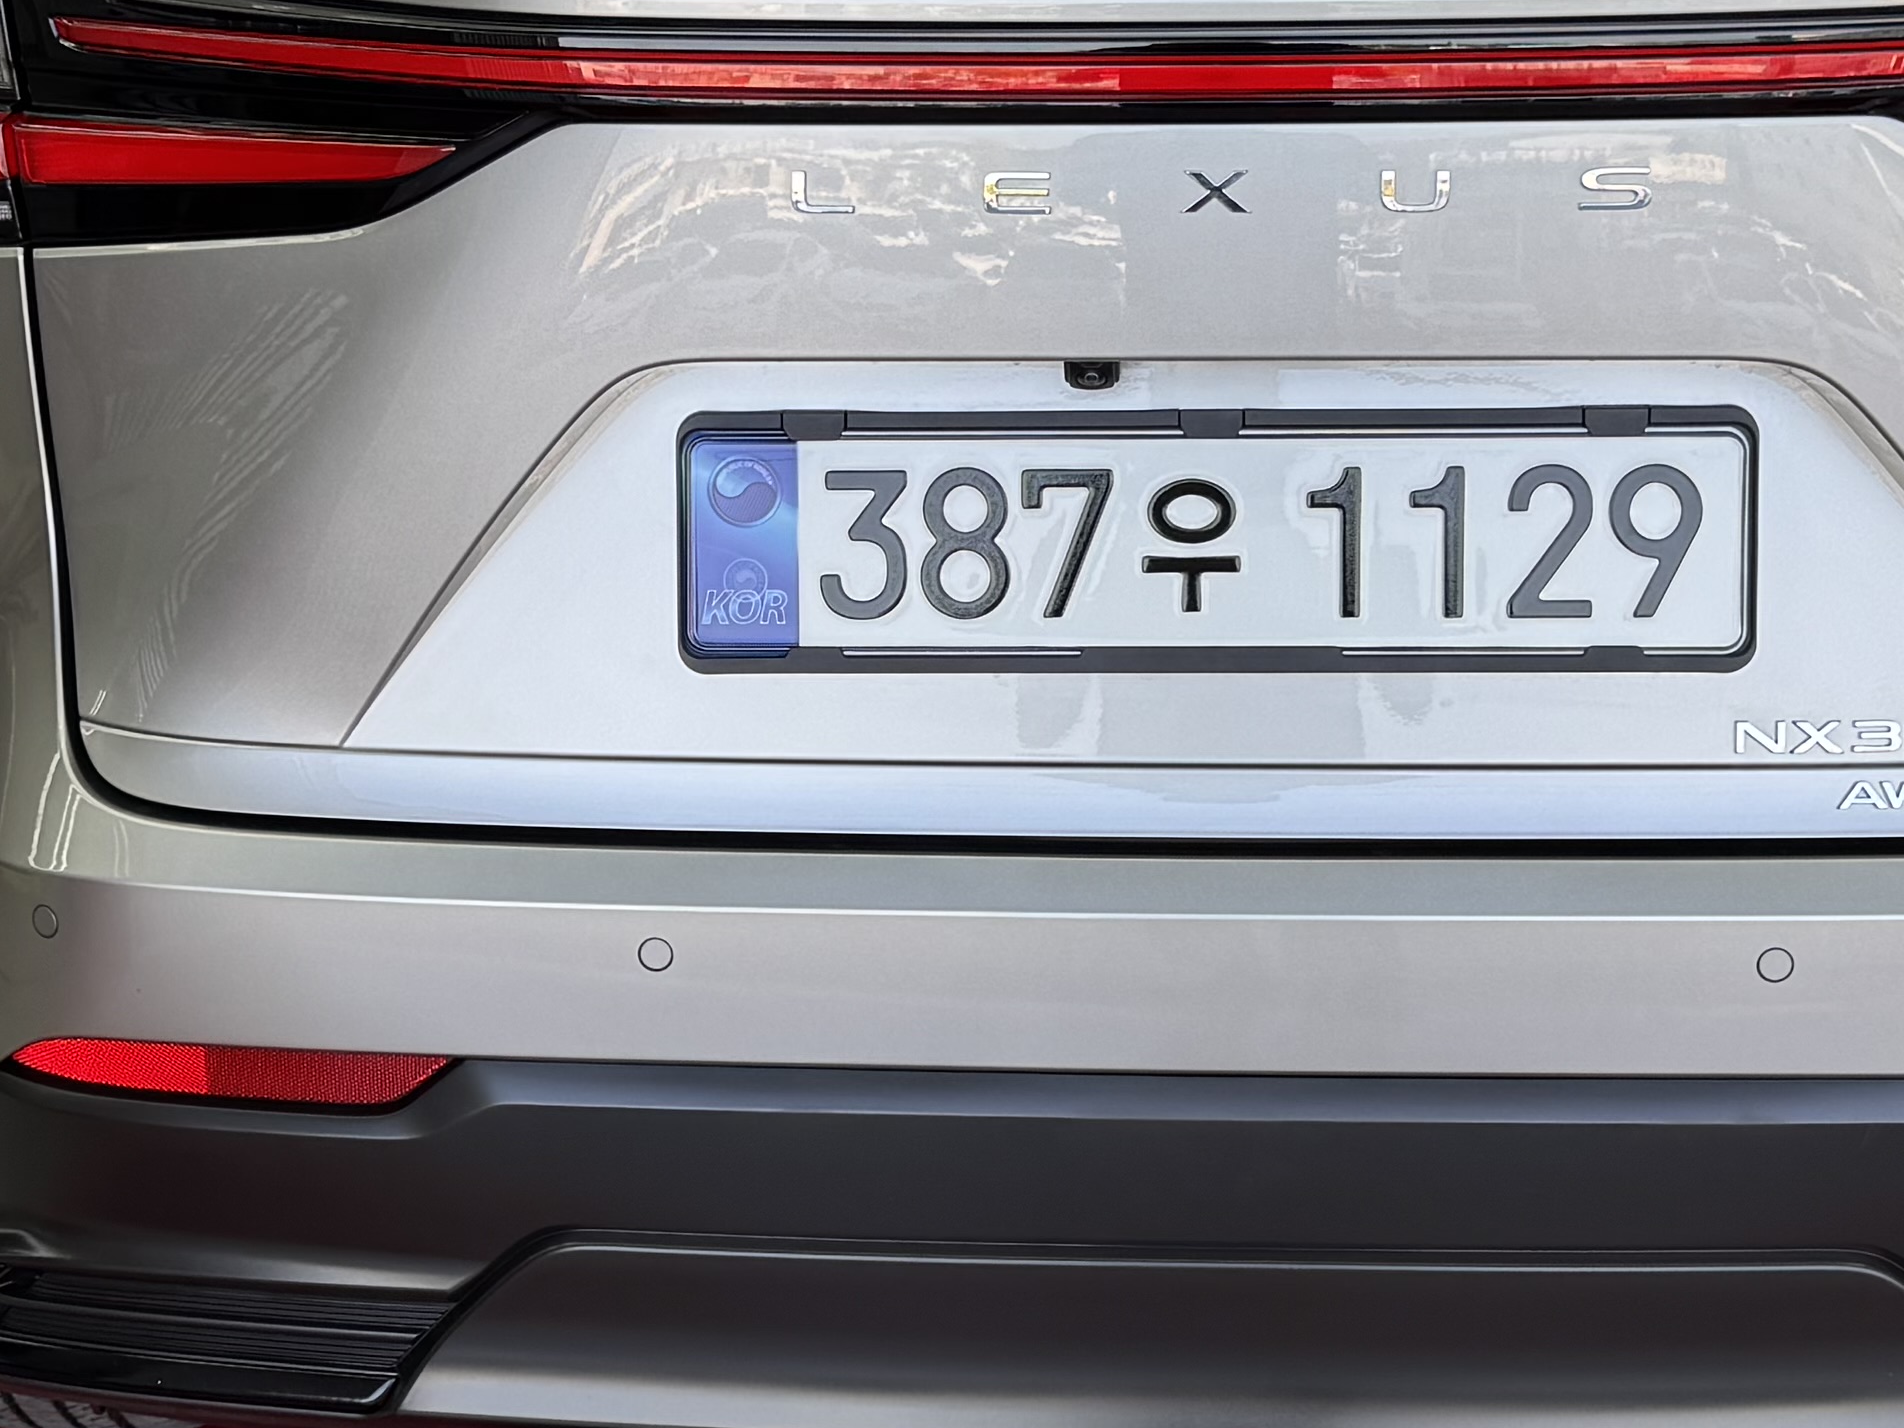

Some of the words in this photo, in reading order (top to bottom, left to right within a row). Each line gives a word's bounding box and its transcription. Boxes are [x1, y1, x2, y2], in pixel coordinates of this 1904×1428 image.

[790, 166, 1653, 215] LEXUS
[820, 466, 1242, 620] 387우
[1306, 464, 1703, 618] 1129
[701, 589, 788, 625] KOR
